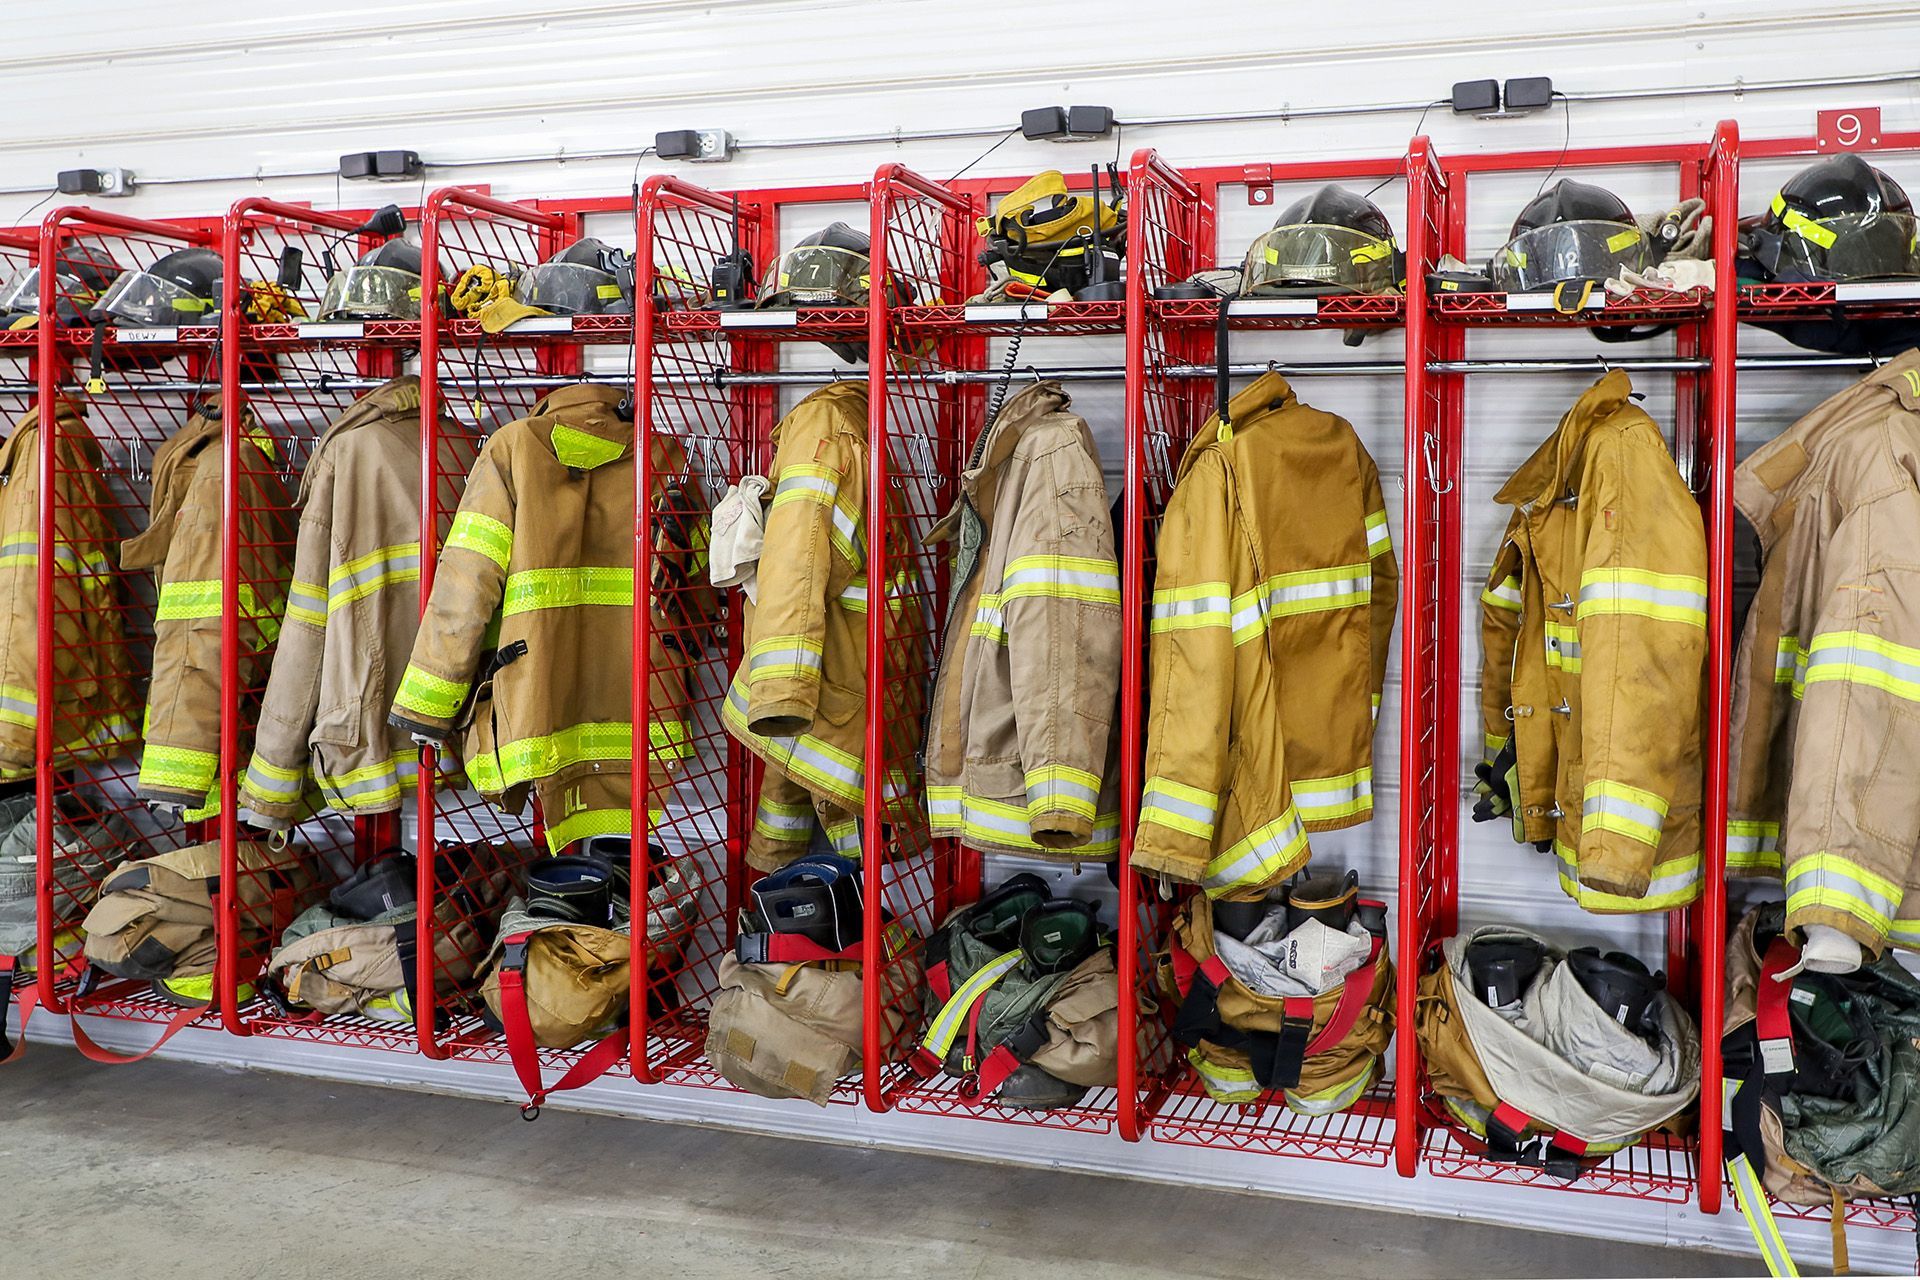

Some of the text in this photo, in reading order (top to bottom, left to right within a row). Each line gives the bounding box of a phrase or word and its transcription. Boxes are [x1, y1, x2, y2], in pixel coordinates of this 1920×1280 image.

[1836, 113, 1862, 146] 9
[1557, 251, 1580, 270] 12
[810, 264, 820, 280] 7
